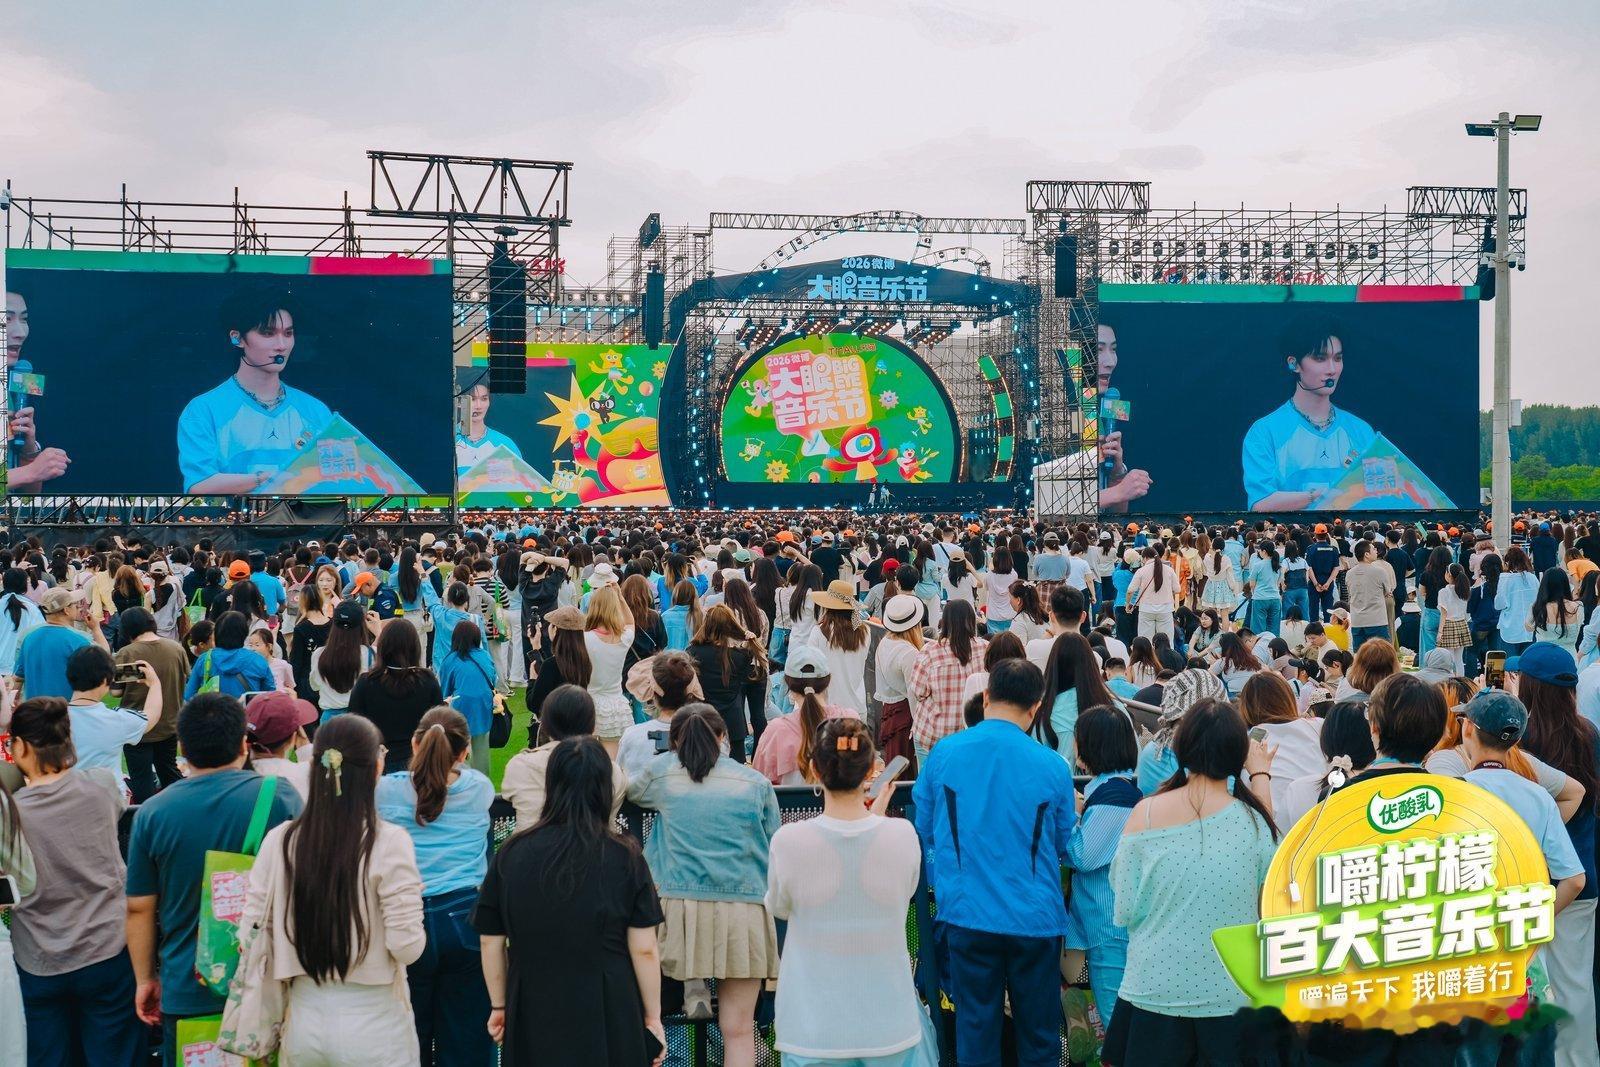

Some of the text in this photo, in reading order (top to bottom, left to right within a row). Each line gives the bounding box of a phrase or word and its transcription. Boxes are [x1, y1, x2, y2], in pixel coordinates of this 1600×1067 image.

[841, 257, 896, 270] 2026微博
[807, 270, 928, 301] 大眼音乐节
[771, 356, 833, 398] 大眼
[775, 389, 866, 428] 音乐节
